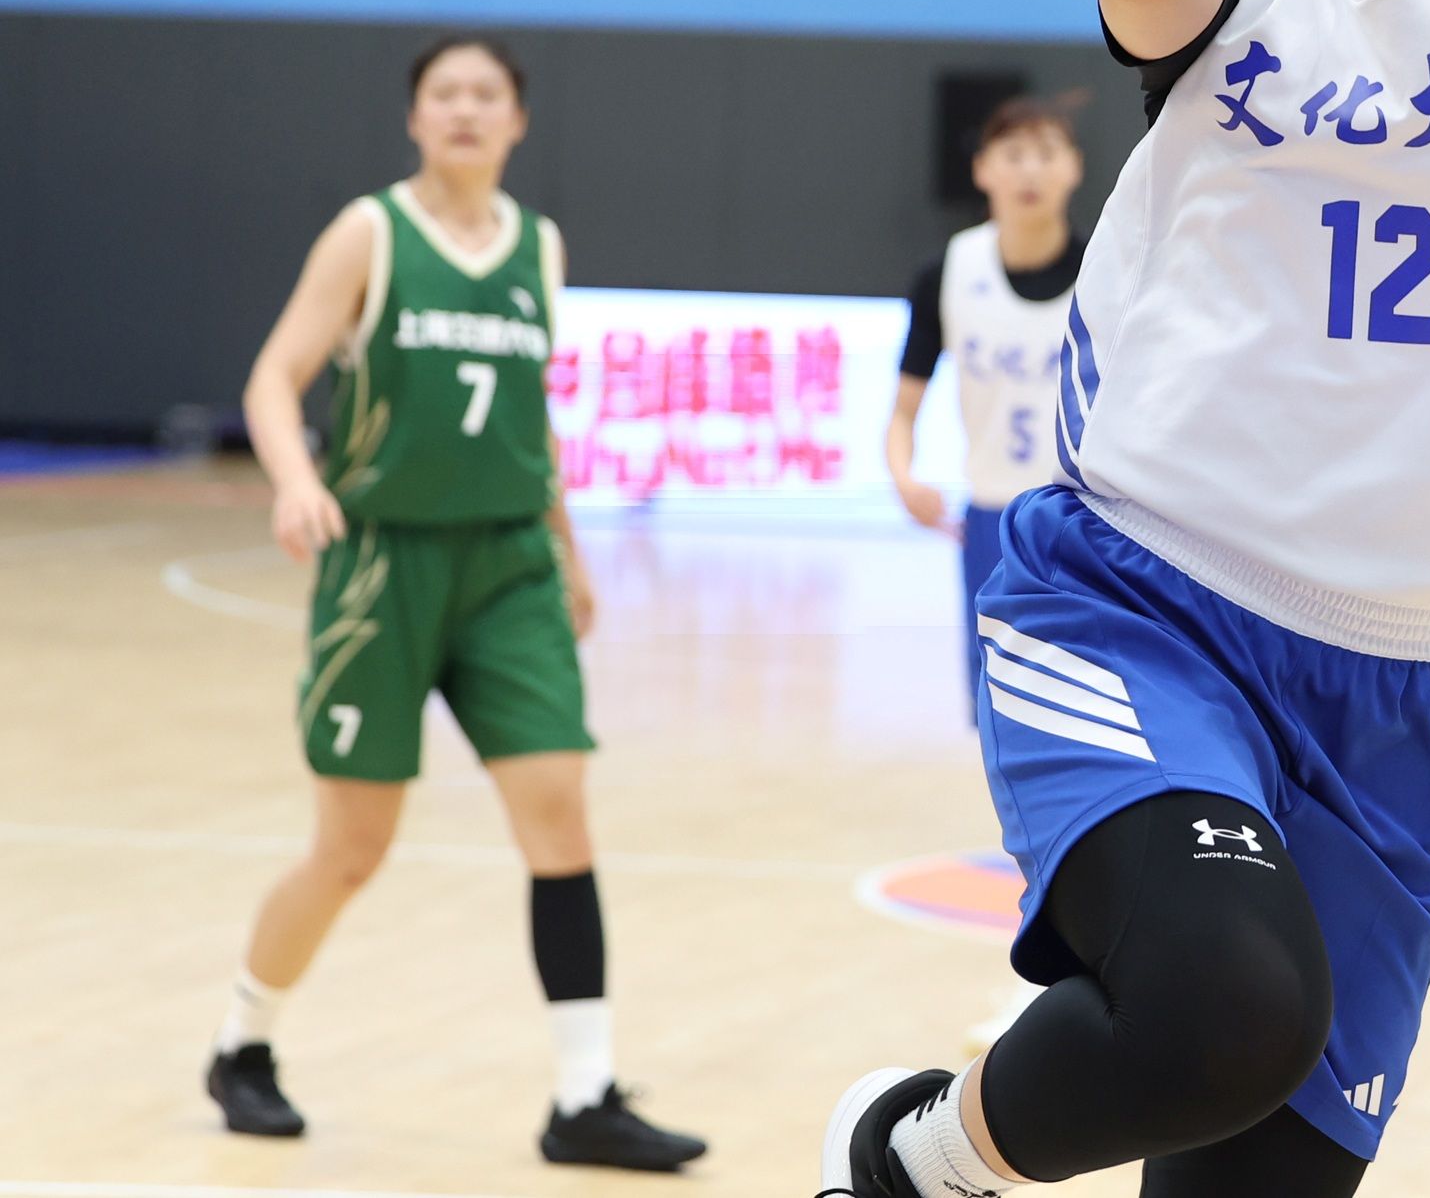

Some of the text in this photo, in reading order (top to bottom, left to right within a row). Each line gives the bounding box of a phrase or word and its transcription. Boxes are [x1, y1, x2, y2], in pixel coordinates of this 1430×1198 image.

[456, 360, 498, 438] 7
[1008, 407, 1036, 463] 5
[328, 703, 363, 758] 7
[1234, 854, 1276, 870] ARMOUR
